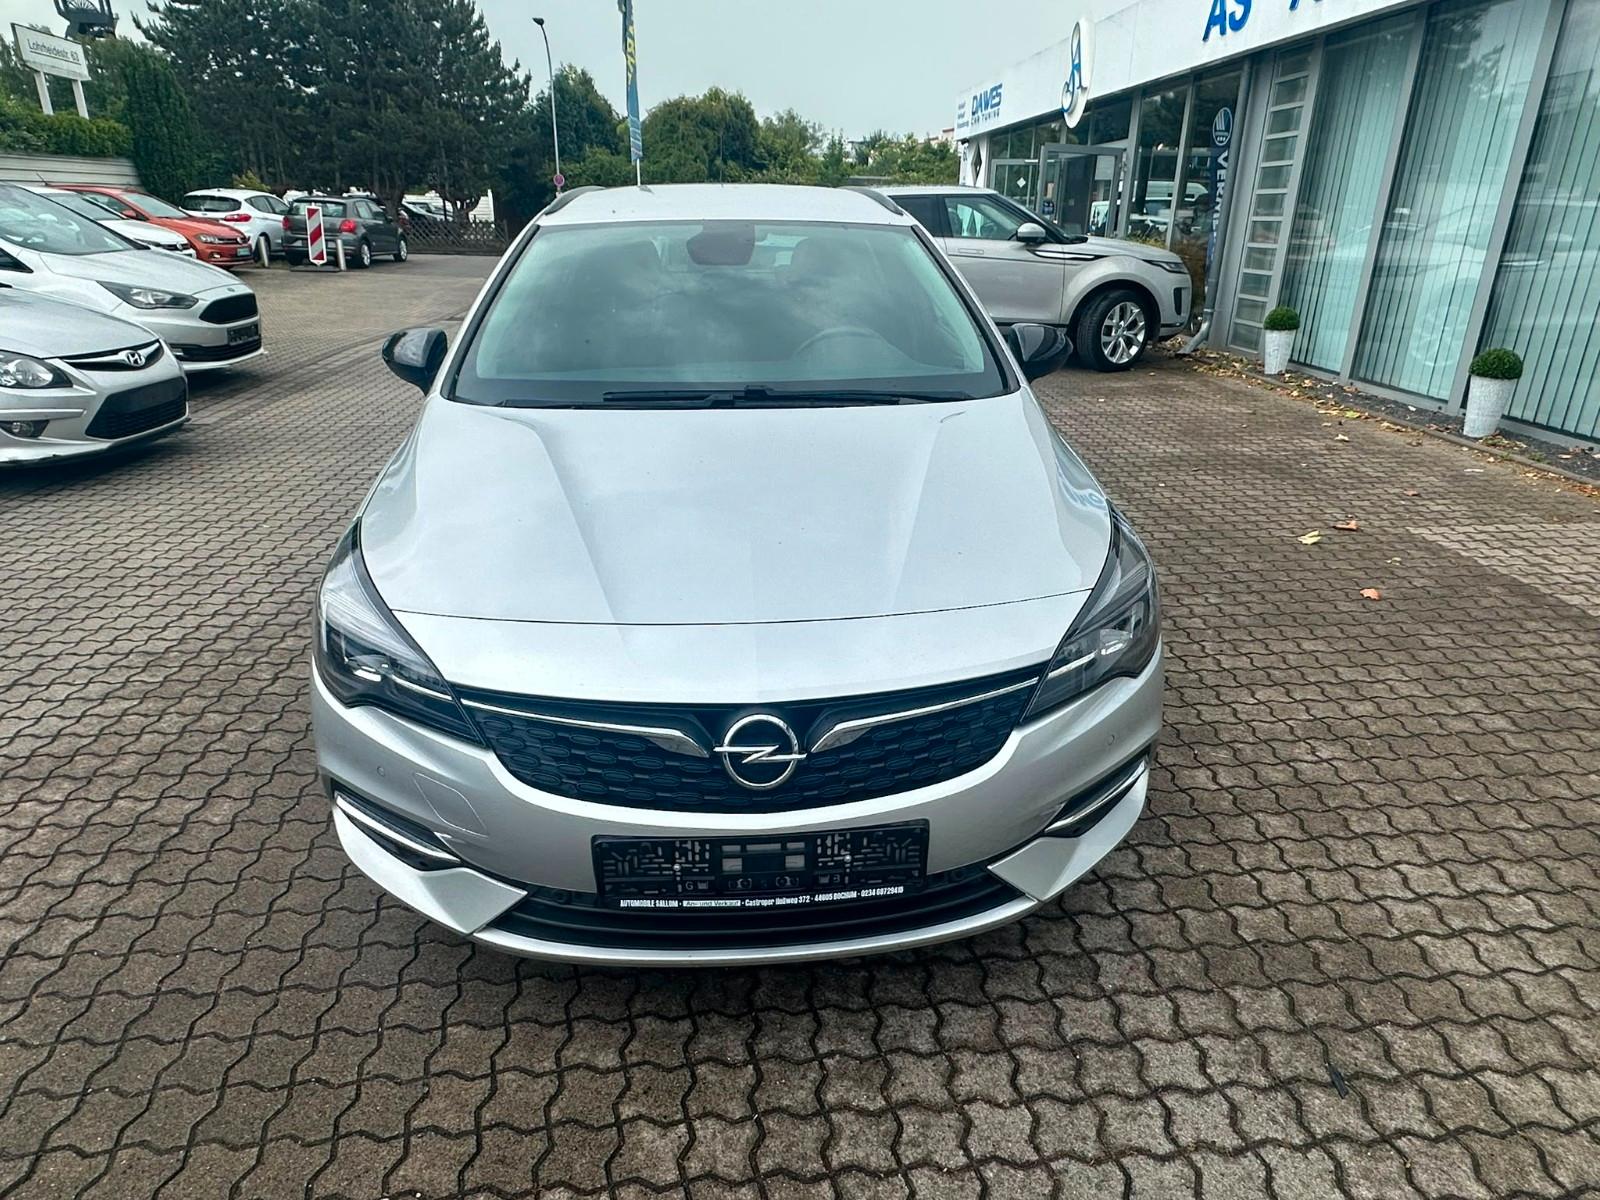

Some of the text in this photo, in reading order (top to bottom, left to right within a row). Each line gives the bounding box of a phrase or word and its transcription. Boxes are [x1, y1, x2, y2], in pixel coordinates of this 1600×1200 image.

[745, 898, 775, 907] Castroper
[798, 895, 811, 903] 372
[833, 890, 857, 900] BOCHUM
[860, 888, 876, 897] 0234
